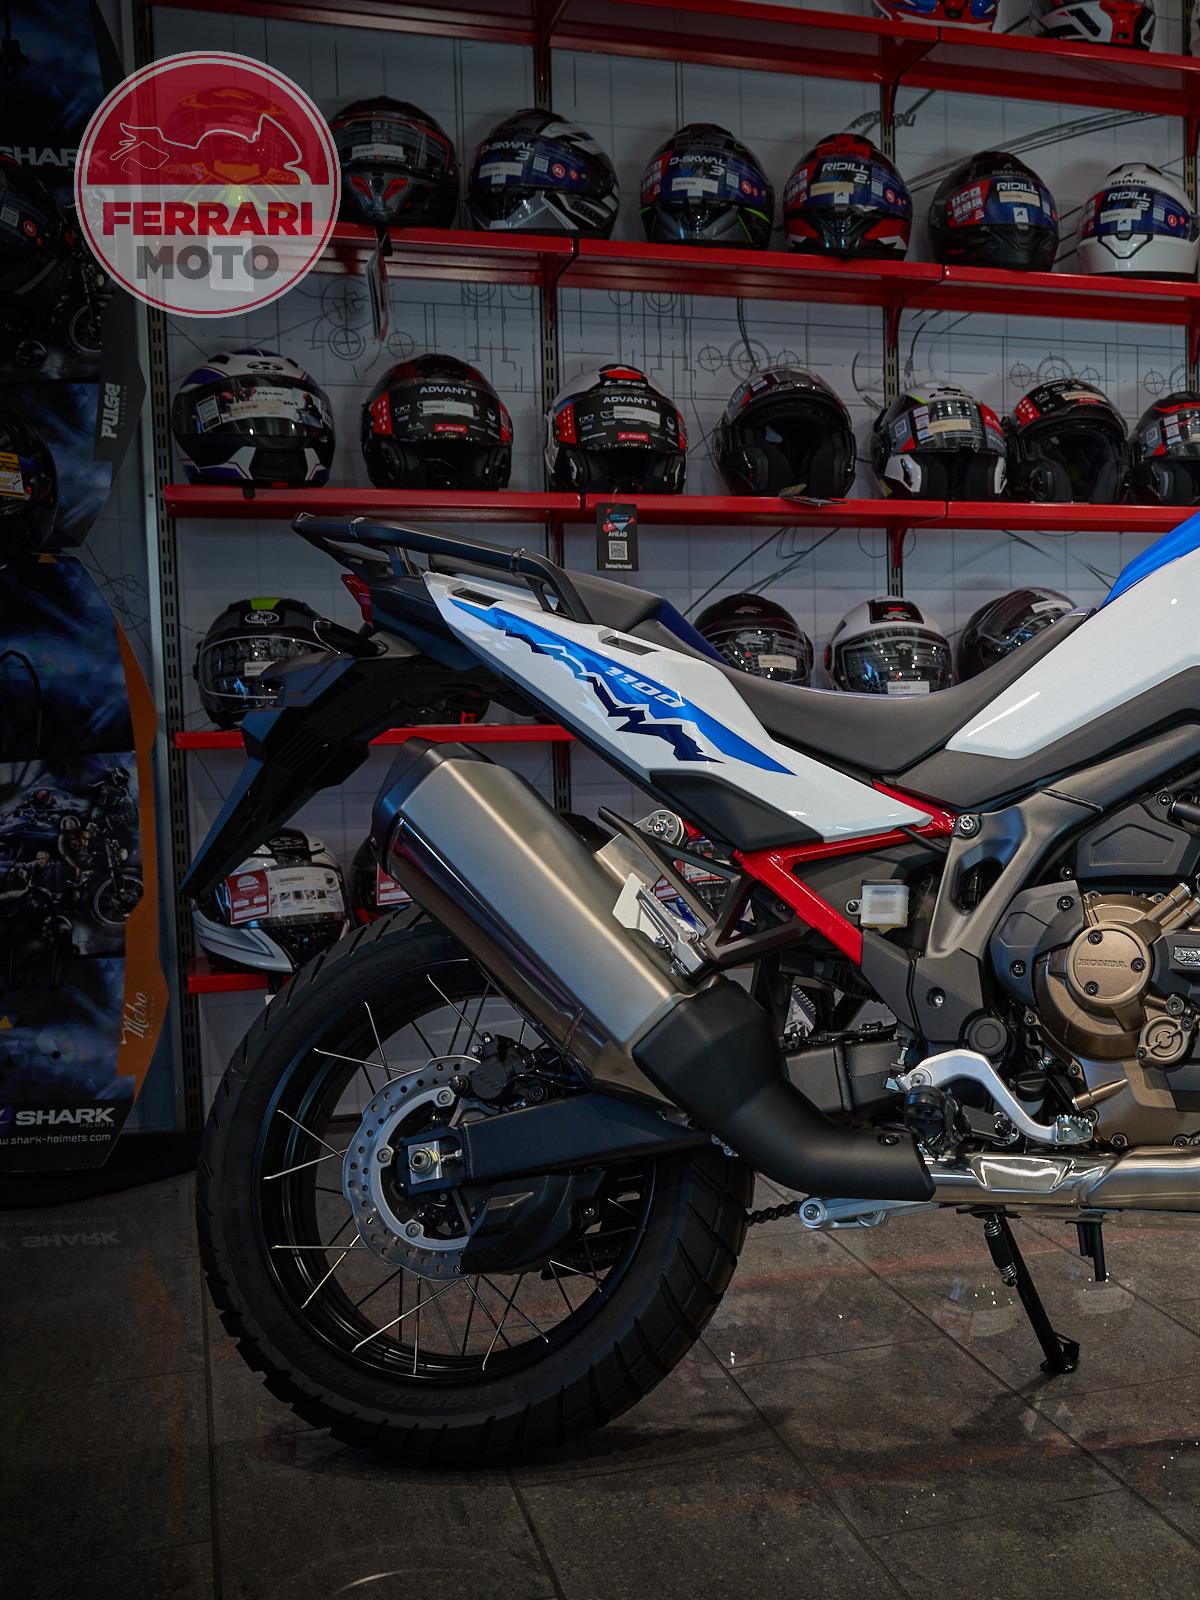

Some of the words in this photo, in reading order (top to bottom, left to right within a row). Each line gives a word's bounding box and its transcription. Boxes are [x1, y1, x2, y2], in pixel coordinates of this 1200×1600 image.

[516, 151, 530, 162] 3
[669, 154, 726, 167] D-SKWAL
[710, 166, 724, 176] 3
[822, 162, 869, 175] RIDILL
[1111, 178, 1148, 186] SHARK
[996, 181, 1039, 195] RIDILL
[1107, 191, 1150, 202] RIDILL
[1136, 201, 1150, 212] 2
[419, 385, 467, 395] ADVANT
[602, 395, 647, 405] ADVANT
[101, 382, 121, 439] PULSE
[606, 666, 686, 708] 1100
[1078, 959, 1128, 968] HONDA
[120, 992, 149, 1045] Metro
[15, 1107, 116, 1126] SHARK
